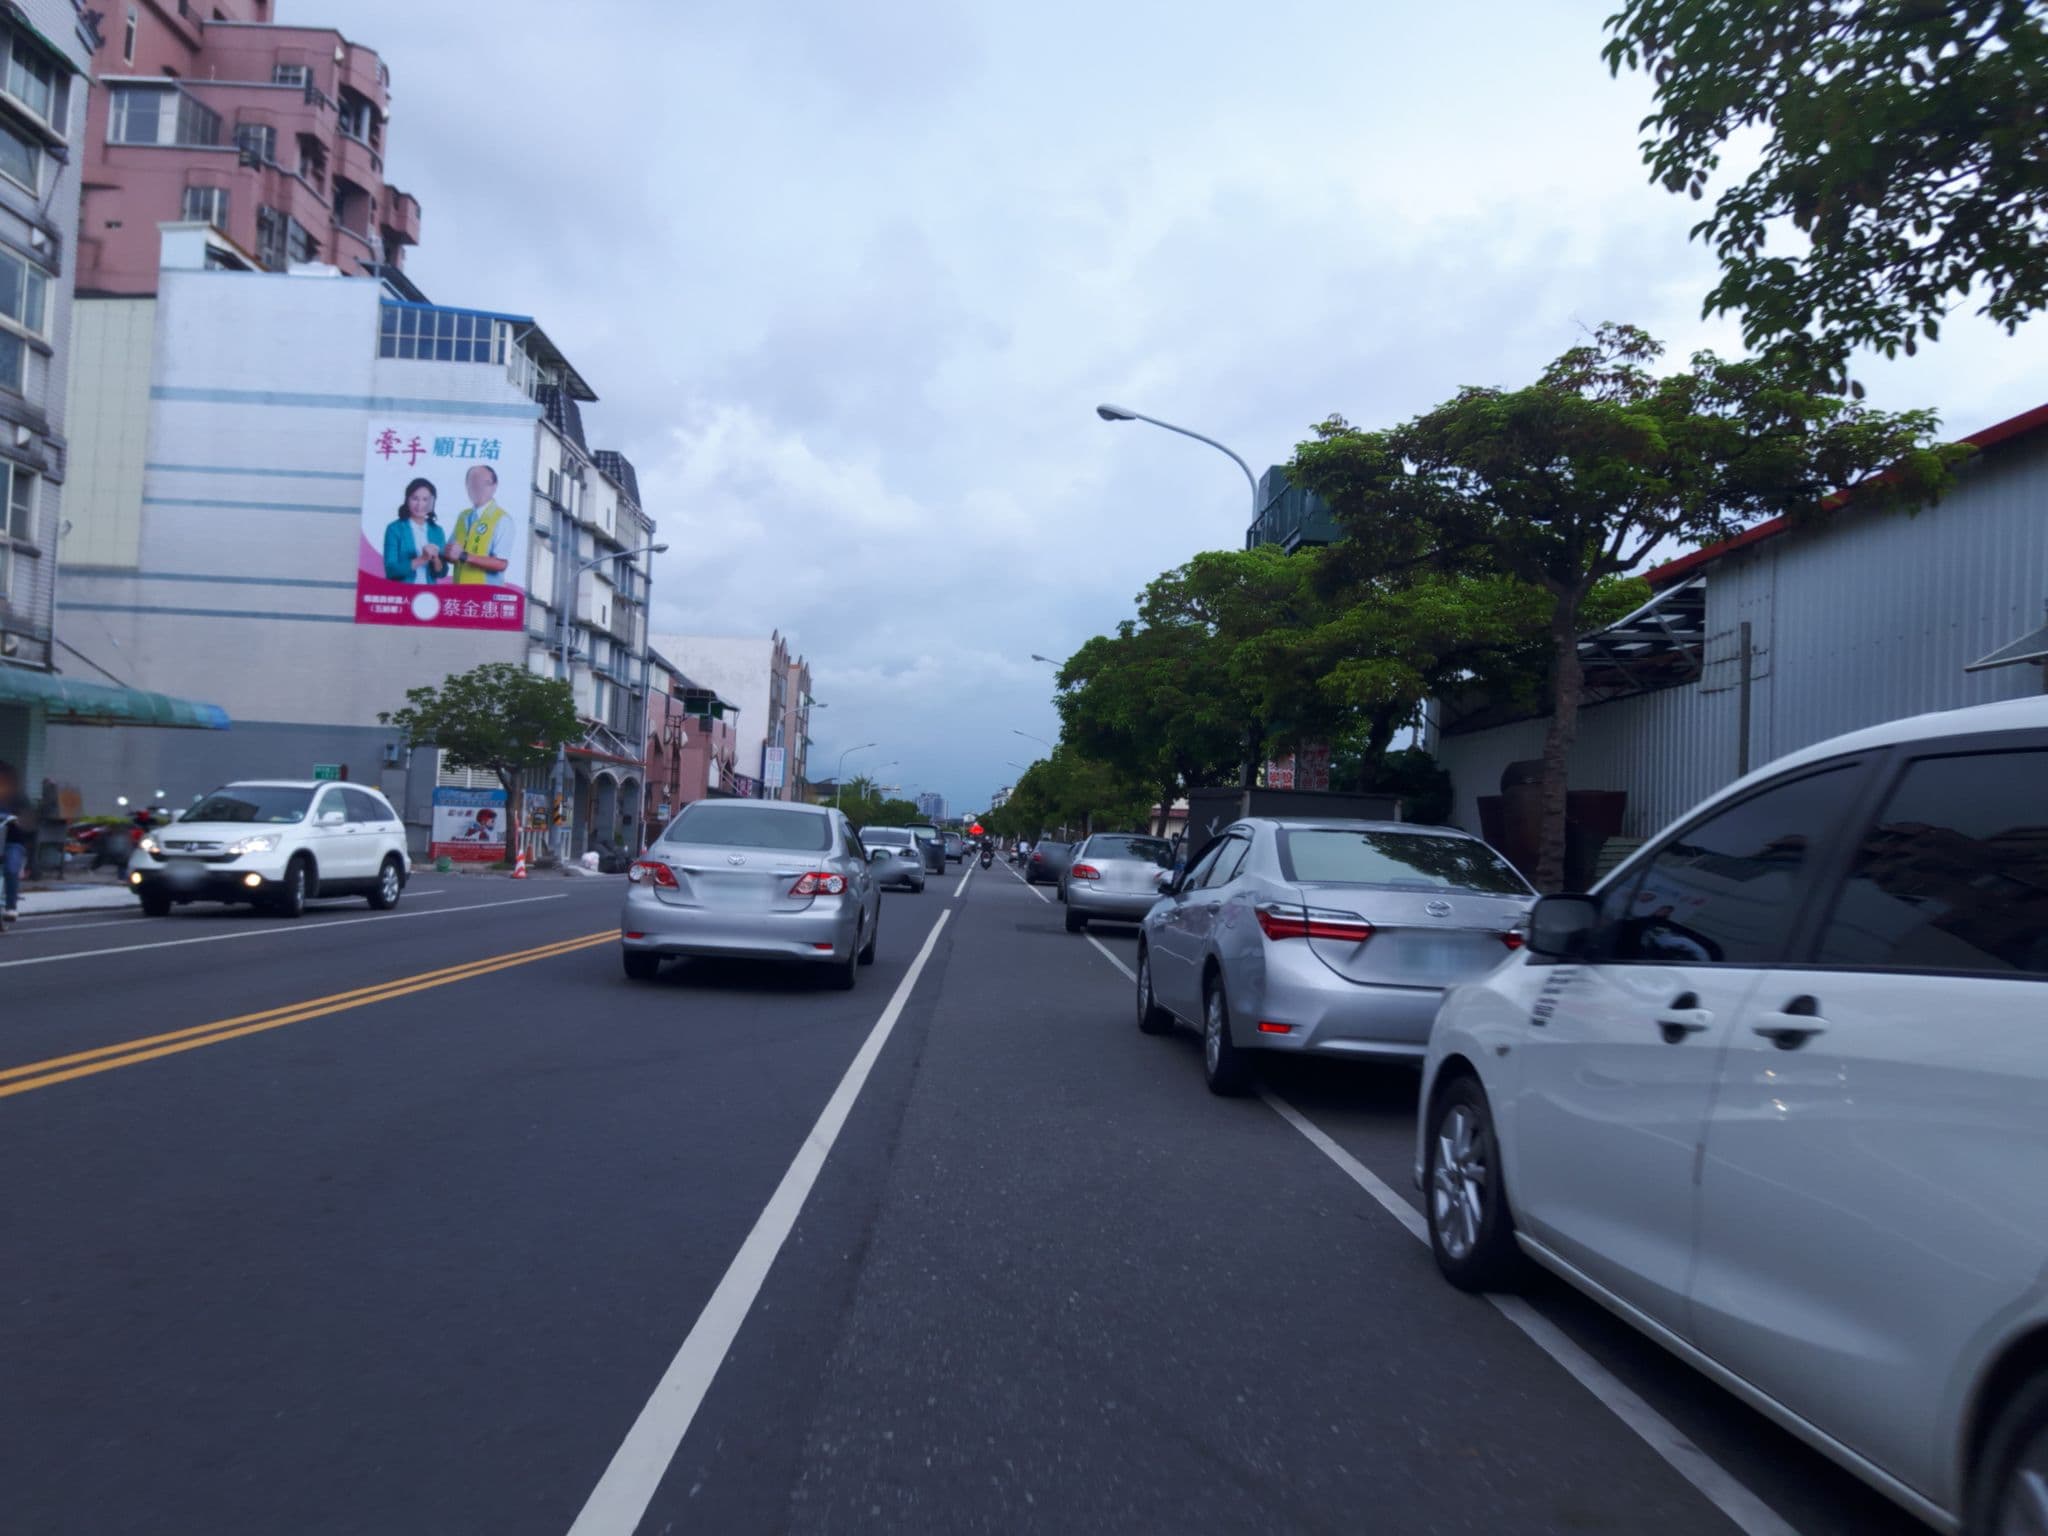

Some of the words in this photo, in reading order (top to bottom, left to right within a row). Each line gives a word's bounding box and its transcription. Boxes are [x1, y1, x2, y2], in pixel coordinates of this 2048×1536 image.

[375, 428, 427, 466] 牽手
[433, 436, 502, 461] 顧五結
[443, 599, 499, 619] 蔡金惠
